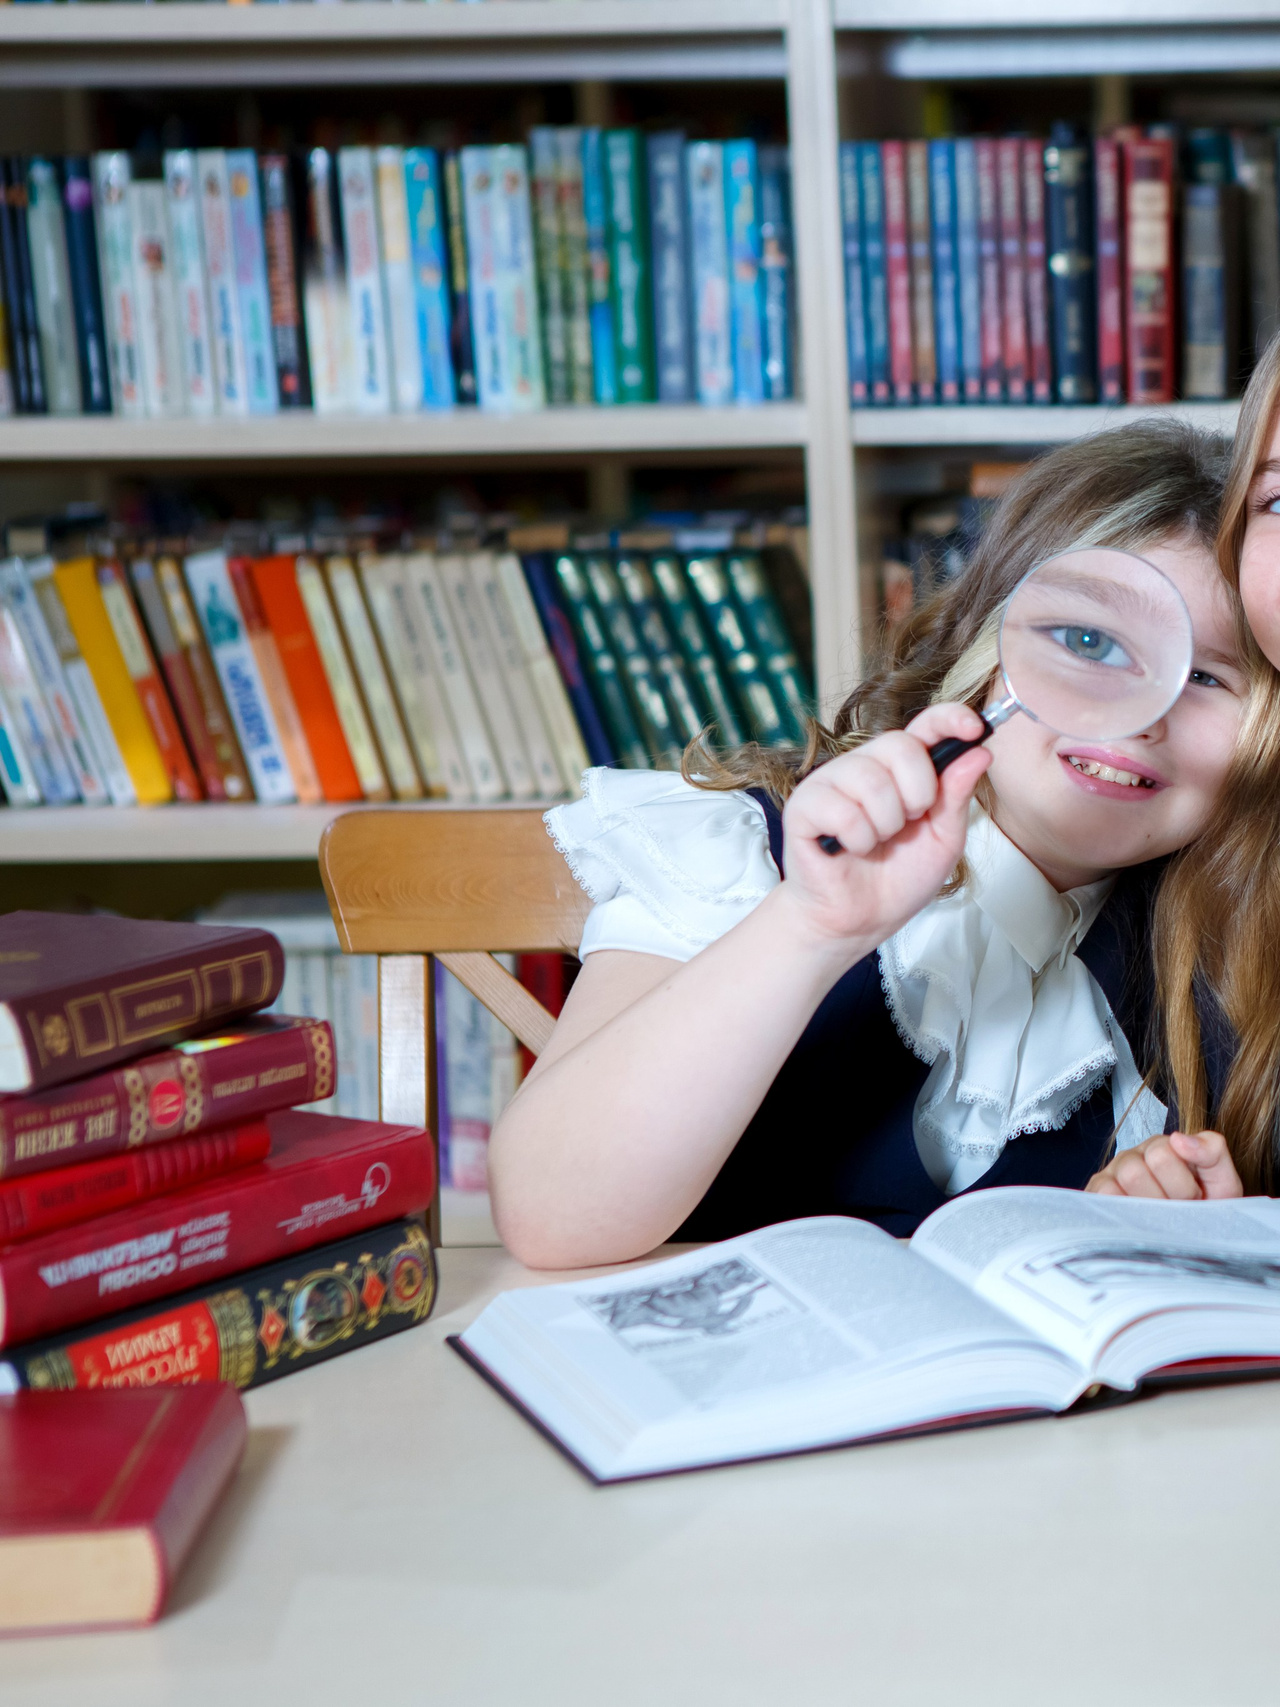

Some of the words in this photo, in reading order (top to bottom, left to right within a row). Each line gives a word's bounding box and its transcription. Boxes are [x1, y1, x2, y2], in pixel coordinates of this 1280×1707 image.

[14, 1121, 78, 1161] ЖИЗНИ
[38, 1228, 176, 1289] МЕНЕДЖМЕНТА
[98, 1253, 178, 1297] ОСНОВЫ
[104, 1320, 181, 1371] АРМИИ
